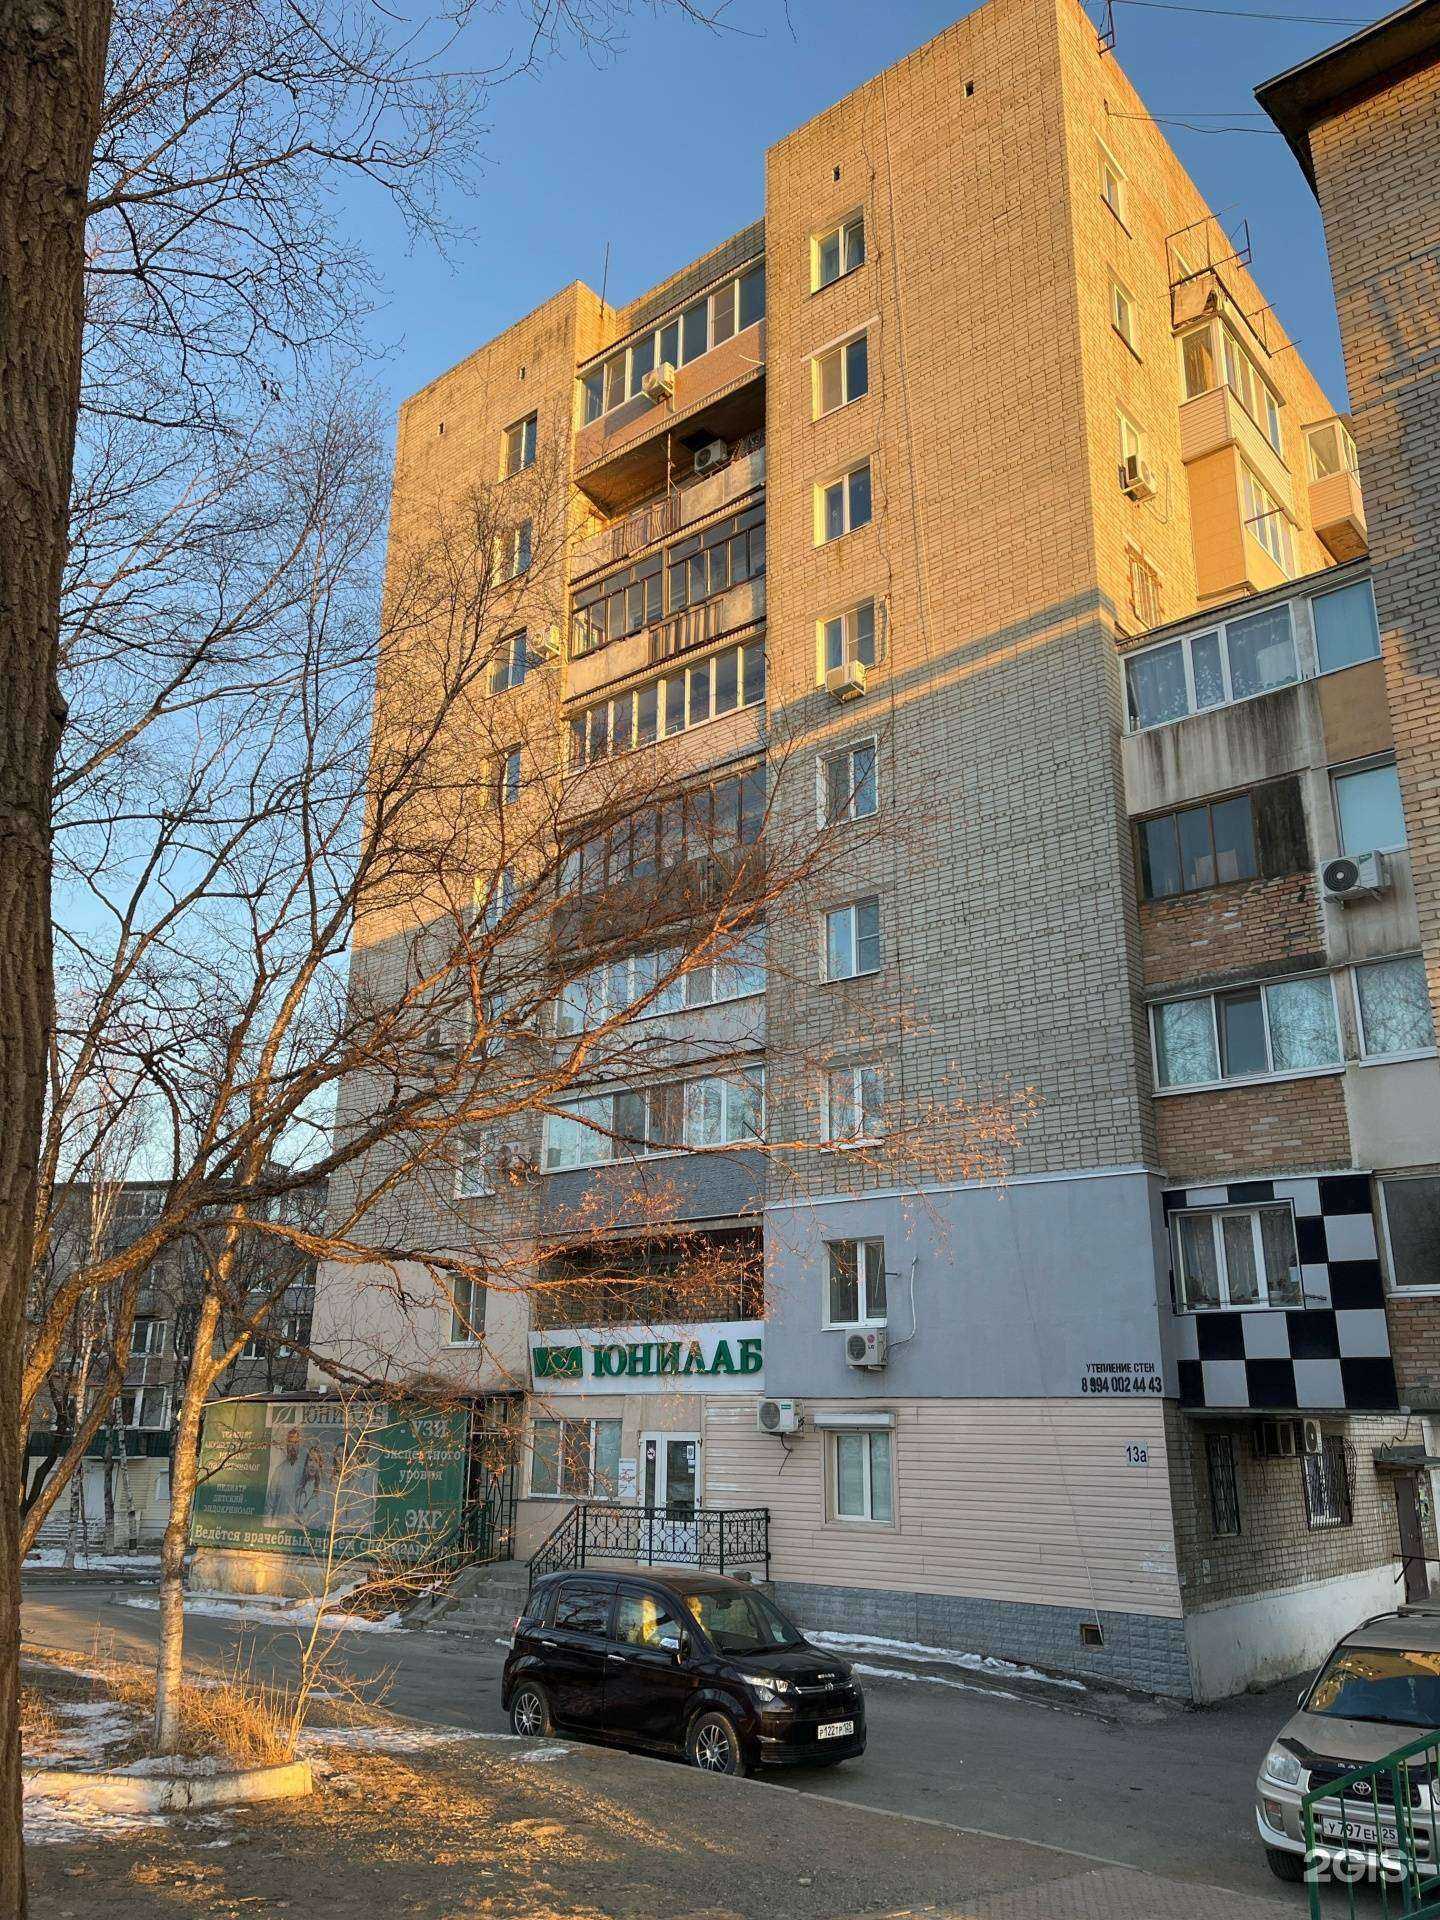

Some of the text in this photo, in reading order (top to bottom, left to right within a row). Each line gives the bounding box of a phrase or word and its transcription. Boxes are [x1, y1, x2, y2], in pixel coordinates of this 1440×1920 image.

[592, 1338, 763, 1377] ЮНИЛАБ
[1086, 1363, 1155, 1373] УТЕПЛЕНИЕ СТЕН
[1081, 1377, 1162, 1393] 8 994 002 44 43
[1126, 1445, 1147, 1463] 13а
[194, 1524, 241, 1541] Ведётся
